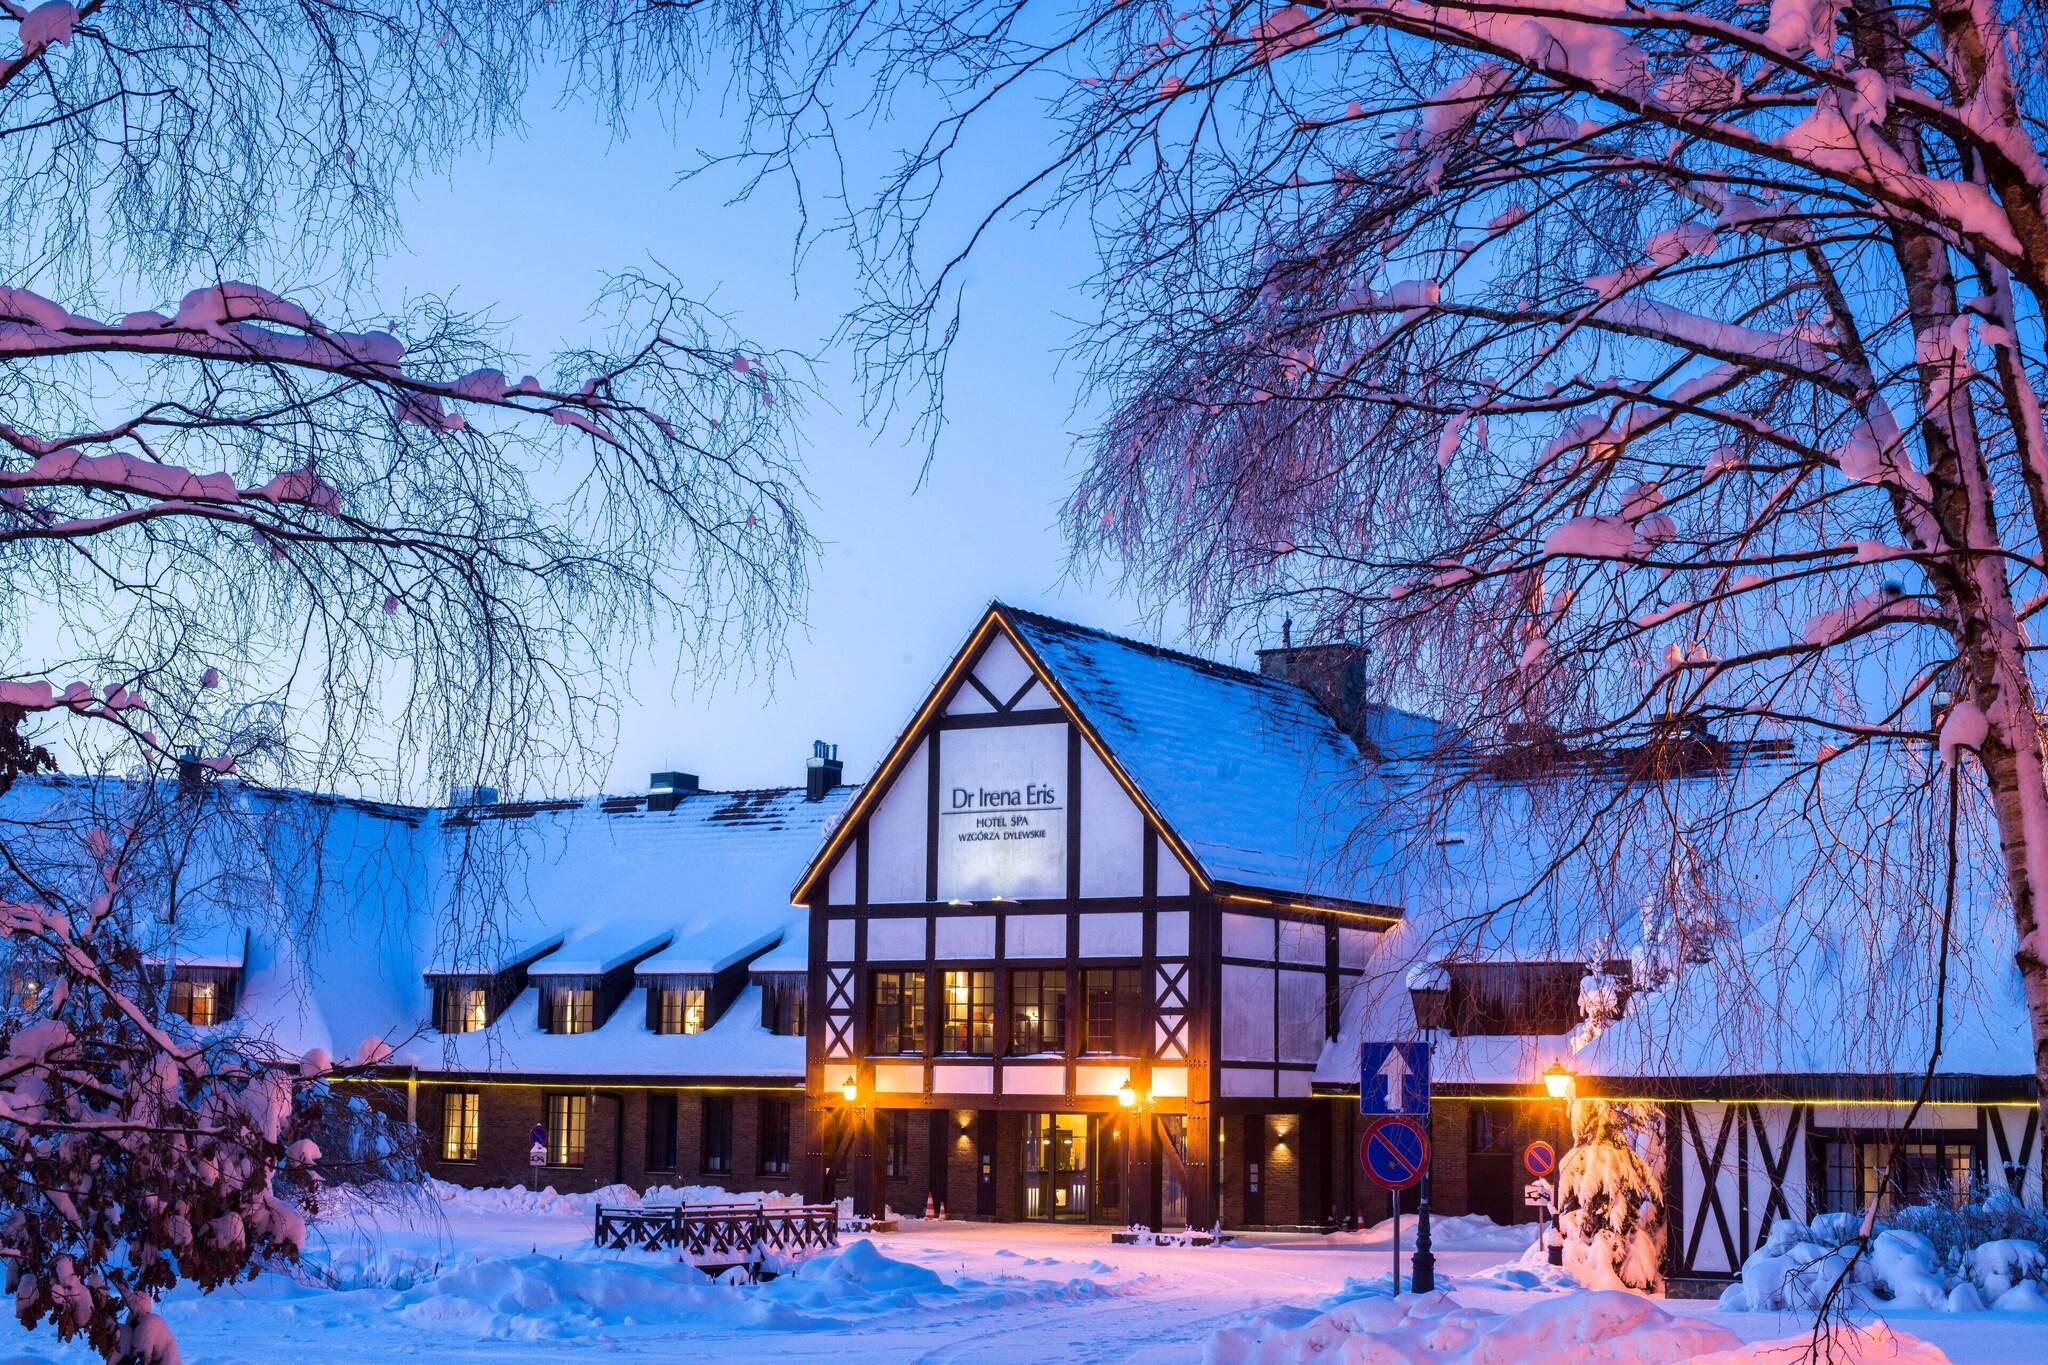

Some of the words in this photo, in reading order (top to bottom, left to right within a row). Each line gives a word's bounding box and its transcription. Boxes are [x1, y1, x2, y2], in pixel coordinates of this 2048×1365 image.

[952, 788, 975, 809] Dr
[979, 787, 1021, 807] Irena
[1026, 784, 1055, 805] Eris
[976, 816, 1007, 829] HOTEL
[1010, 815, 1029, 827] SPA
[958, 831, 1000, 842] WZGÓRZA
[1003, 829, 1047, 841] DYLEWSKIE
